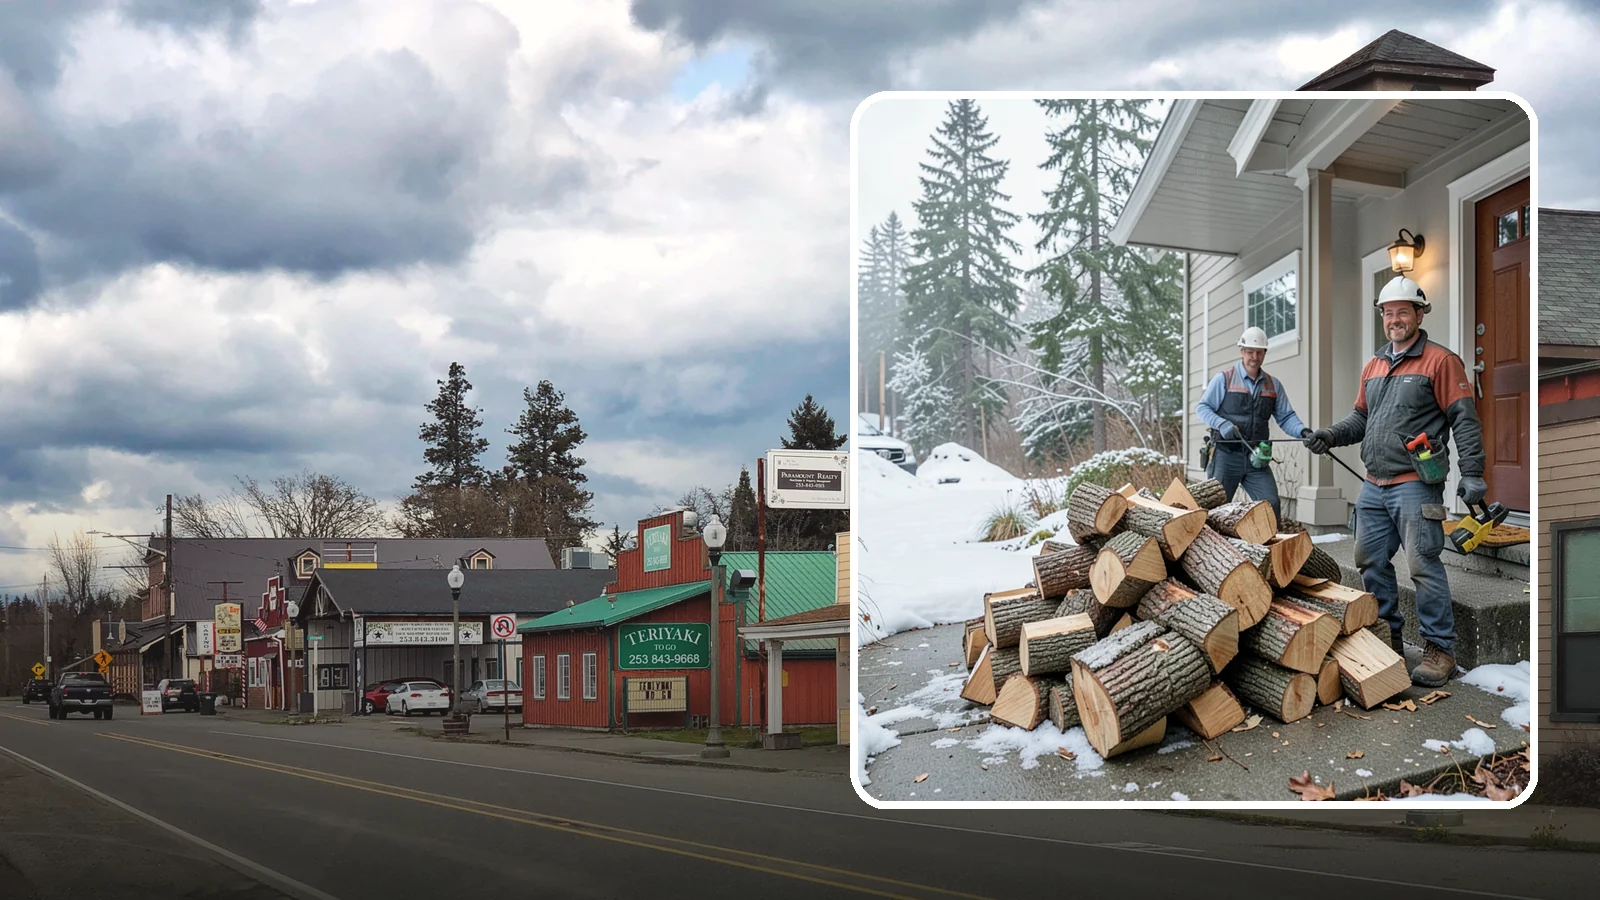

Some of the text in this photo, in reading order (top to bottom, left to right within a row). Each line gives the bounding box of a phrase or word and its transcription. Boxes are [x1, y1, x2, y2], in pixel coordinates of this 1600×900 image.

[781, 471, 838, 480] PARAMOUNT REALTY
[646, 531, 669, 549] TERIYAKI
[624, 627, 702, 646] TERIYAKI
[629, 653, 700, 664] 253 843-9668
